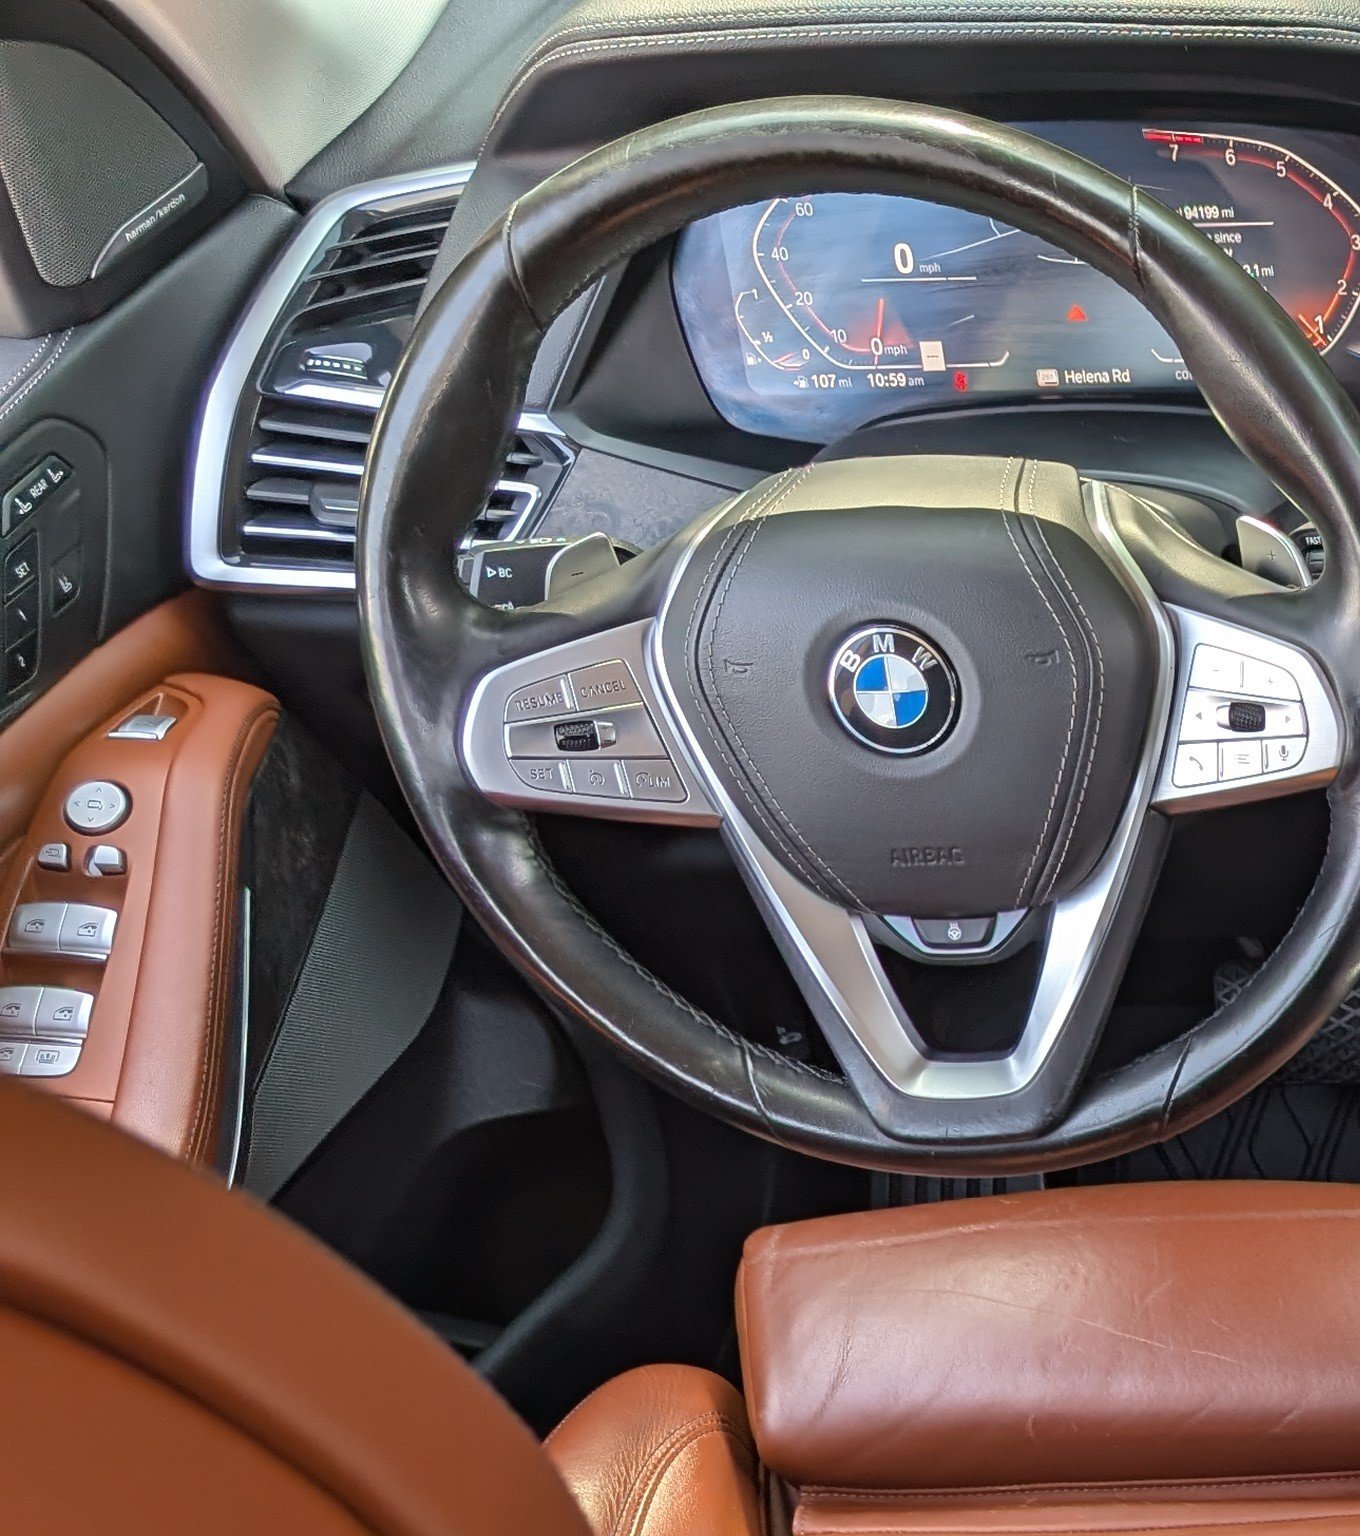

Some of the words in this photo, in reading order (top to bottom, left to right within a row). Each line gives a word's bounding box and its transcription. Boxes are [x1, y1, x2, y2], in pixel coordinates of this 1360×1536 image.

[1169, 144, 1179, 162] 7
[1225, 149, 1236, 166] 6
[1276, 161, 1287, 178] 5
[1323, 193, 1333, 210] 4
[795, 203, 813, 216] 60
[1184, 206, 1219, 219] 94199
[1221, 207, 1235, 218] mi
[1214, 231, 1242, 243] since
[1351, 235, 1360, 251] 3
[771, 247, 788, 261] 40
[894, 243, 914, 274] 0
[919, 263, 941, 273] mph
[1261, 265, 1275, 277] mi
[1337, 280, 1347, 296] 2
[795, 292, 812, 306] 20
[1315, 315, 1324, 333] 1
[831, 330, 847, 342] 10
[871, 338, 882, 355] 0
[884, 345, 908, 355] mph
[803, 349, 810, 360] 0
[811, 375, 835, 388] 107
[839, 376, 852, 388] mi
[867, 373, 906, 387] 10:59
[908, 376, 925, 386] am
[1064, 369, 1109, 384] Helena
[1112, 369, 1130, 383] Rd
[29, 478, 49, 499] REAR
[1306, 536, 1322, 546] FAST
[15, 562, 30, 579] SET
[498, 567, 512, 578] BC
[840, 633, 938, 673] BMW
[17, 654, 25, 668] 2
[580, 680, 627, 698] CANCEL
[515, 692, 564, 712] RESUME
[530, 768, 554, 780] SET
[648, 776, 670, 787] LIM
